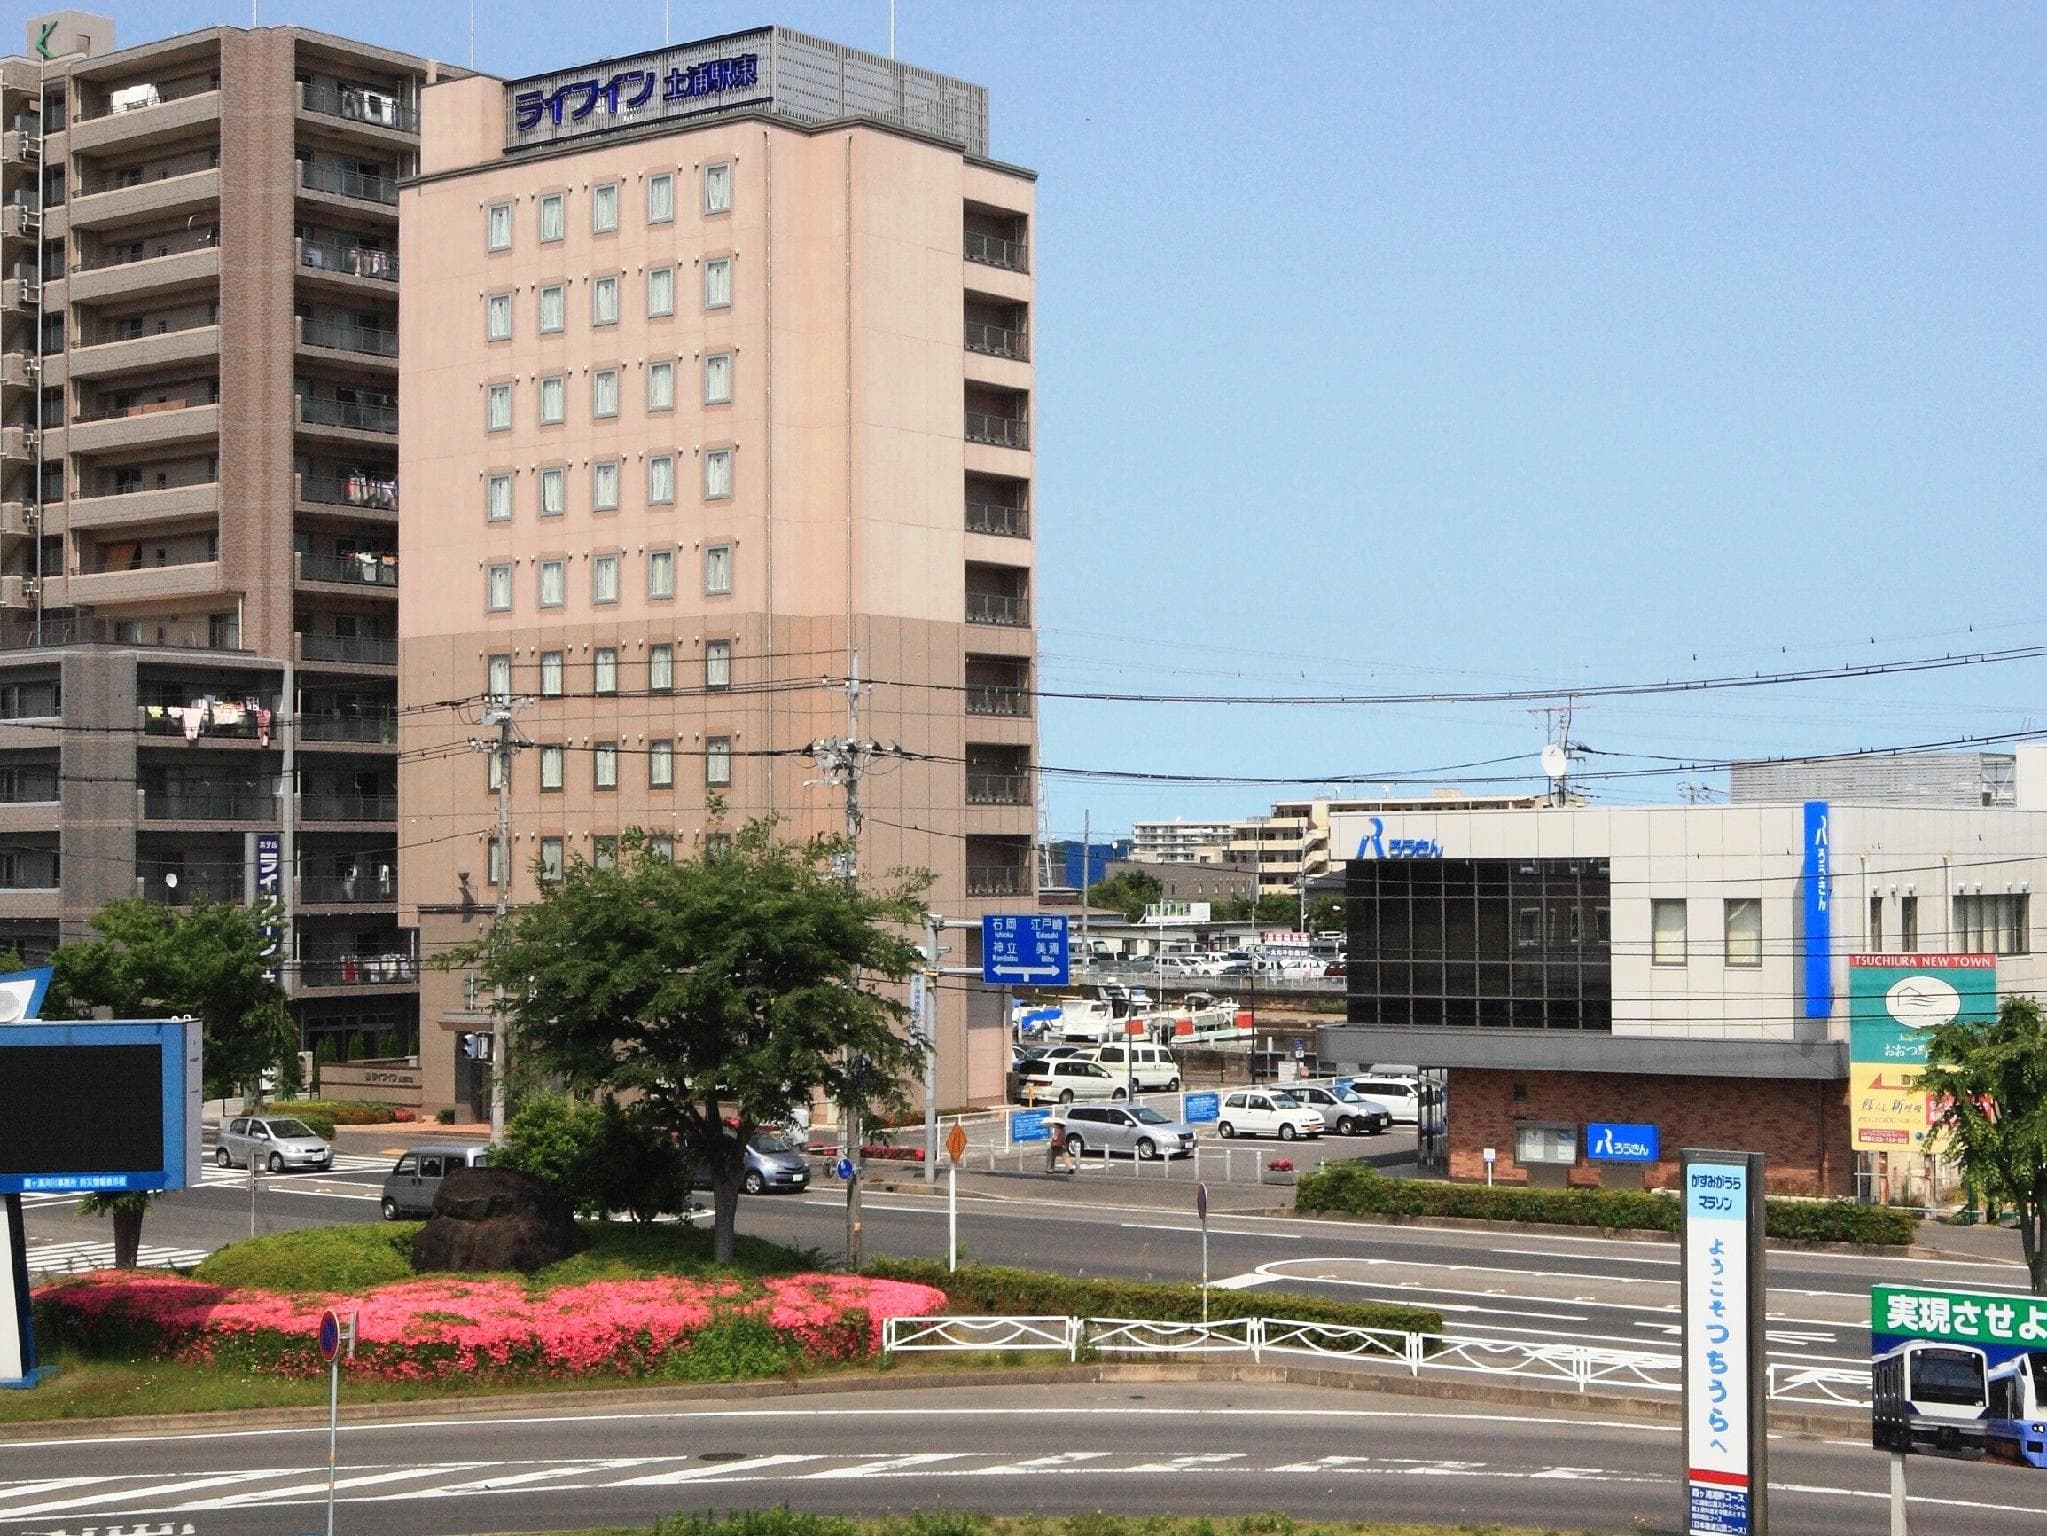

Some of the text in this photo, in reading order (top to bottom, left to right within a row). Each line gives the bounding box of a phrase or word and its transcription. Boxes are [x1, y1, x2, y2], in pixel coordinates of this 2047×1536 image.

[515, 53, 759, 131] ライフイン 土浦駅東
[992, 917, 1017, 931] 石岡
[993, 941, 1018, 954] 神立
[1855, 955, 1991, 967] TSUCHIURA NEW TOWN
[1613, 1142, 1649, 1157] ろうきん
[1691, 1174, 1742, 1190] かすみがうら
[1698, 1195, 1733, 1211] マラソン
[1886, 1293, 2047, 1341] 実現させよ
